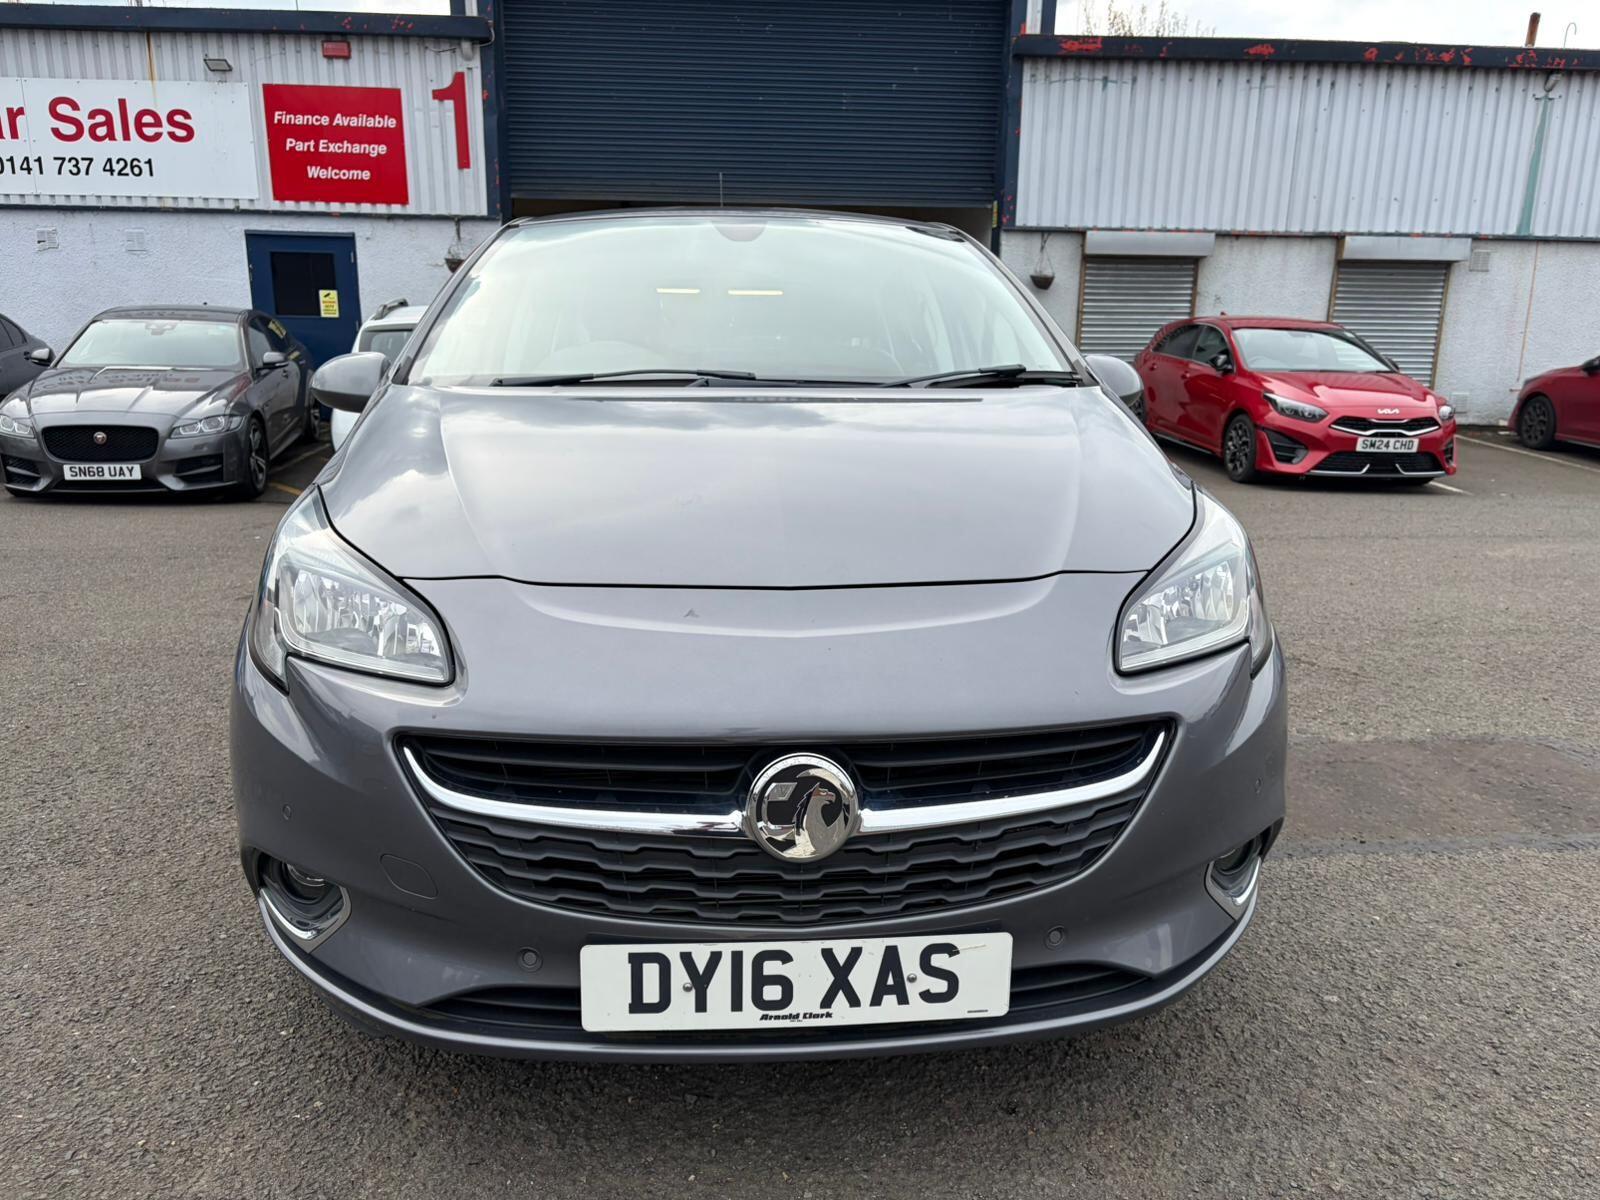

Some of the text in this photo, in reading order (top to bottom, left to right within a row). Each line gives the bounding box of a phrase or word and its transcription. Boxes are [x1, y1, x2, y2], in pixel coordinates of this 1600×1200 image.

[0, 96, 196, 143] r Sales
[274, 111, 397, 128] Finance Available
[432, 72, 471, 169] 1
[286, 138, 388, 157] Part Exchange
[53, 156, 94, 176] 737
[102, 157, 154, 177] 4261
[307, 166, 371, 180] Welcome
[1361, 439, 1414, 450] SM24 CHD
[69, 466, 134, 477] SN68 UAY
[628, 942, 960, 1014] DY16 XAS
[759, 1012, 800, 1021] Arnold
[802, 1011, 833, 1019] Clark
